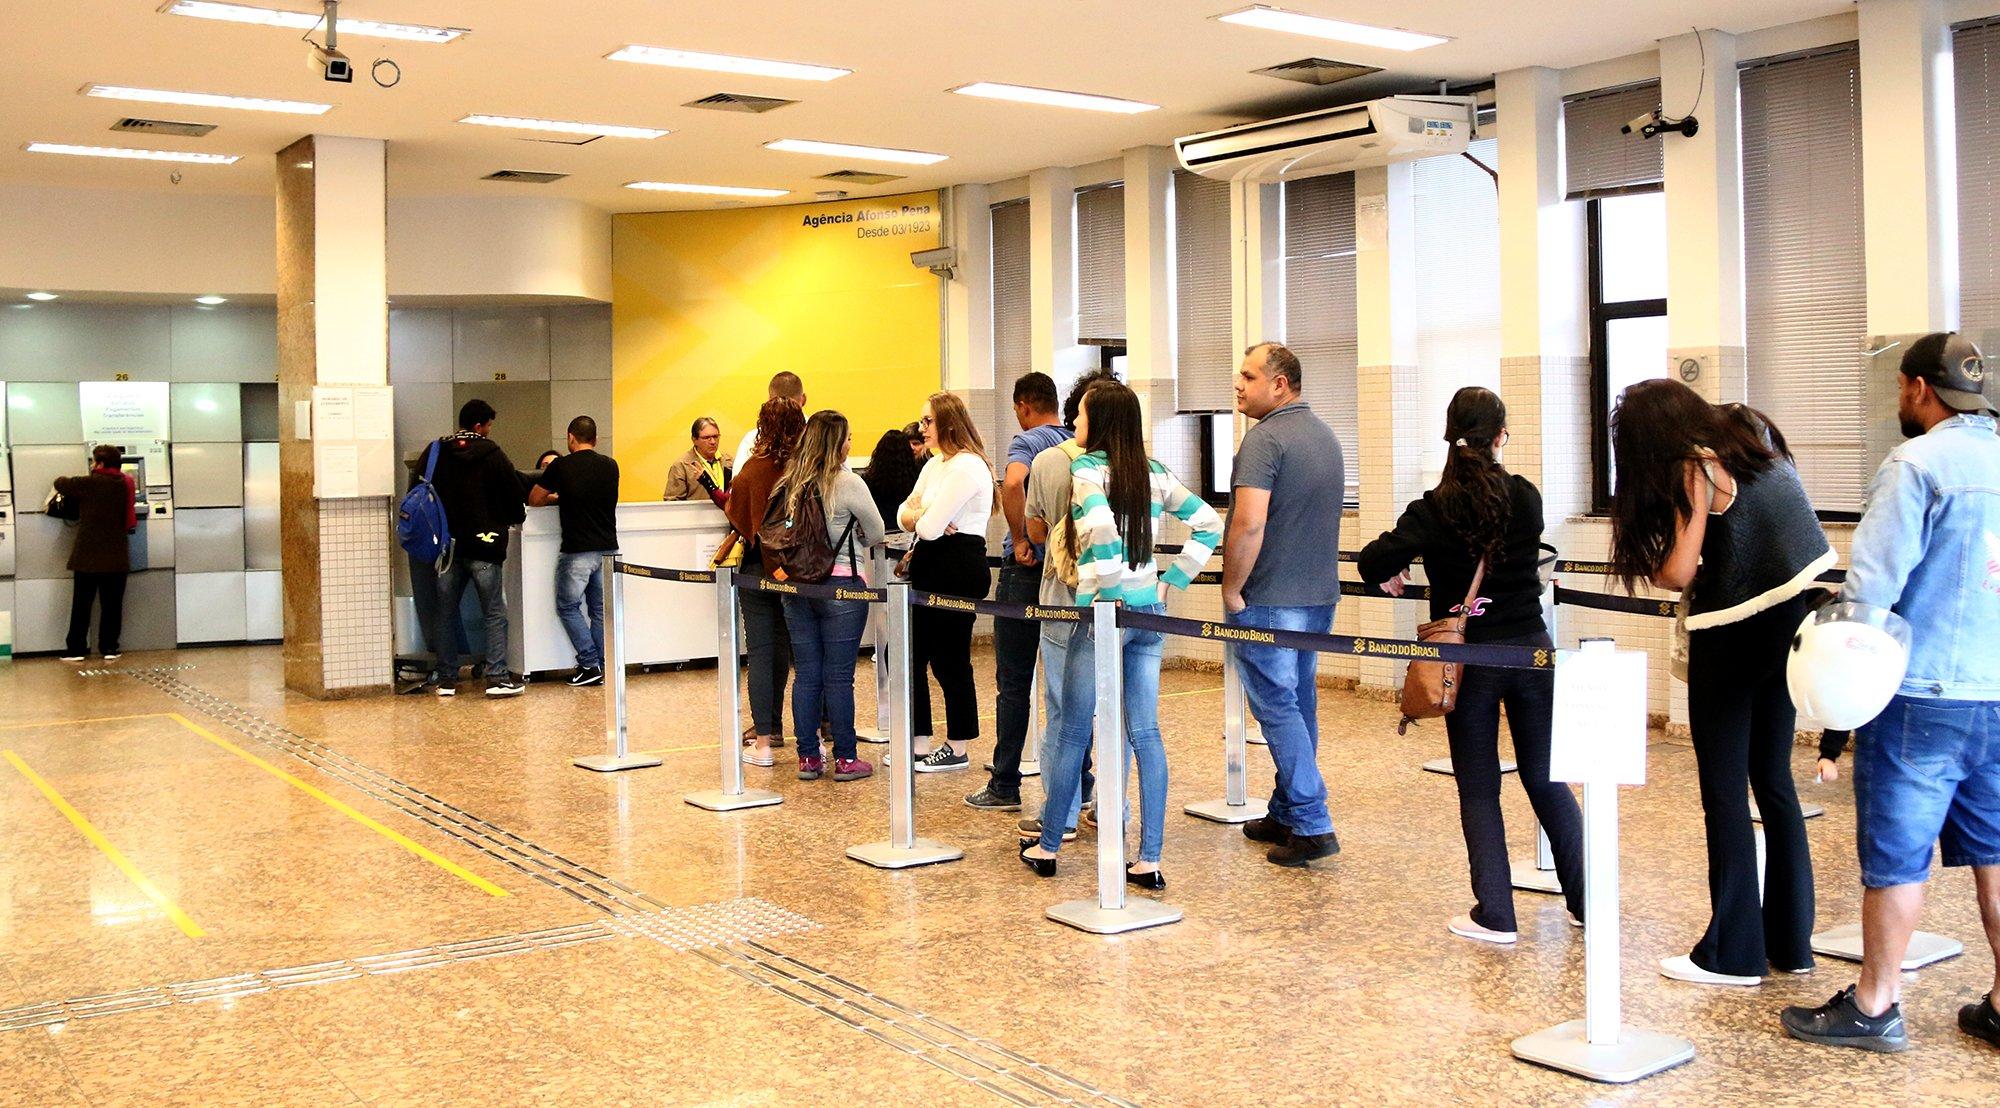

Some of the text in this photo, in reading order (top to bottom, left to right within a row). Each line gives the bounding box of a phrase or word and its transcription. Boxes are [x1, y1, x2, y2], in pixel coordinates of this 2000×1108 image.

[802, 205, 930, 228] Agência Afonso Pena
[857, 220, 931, 239] Desde 03/1923
[116, 373, 129, 381] 26
[494, 372, 506, 381] 28
[1034, 607, 1053, 619] BANCO
[1061, 609, 1081, 620] BRASIL
[1214, 625, 1275, 643] BANCO DO BRASIL
[1368, 640, 1441, 658] BANCO DO BRASIL
